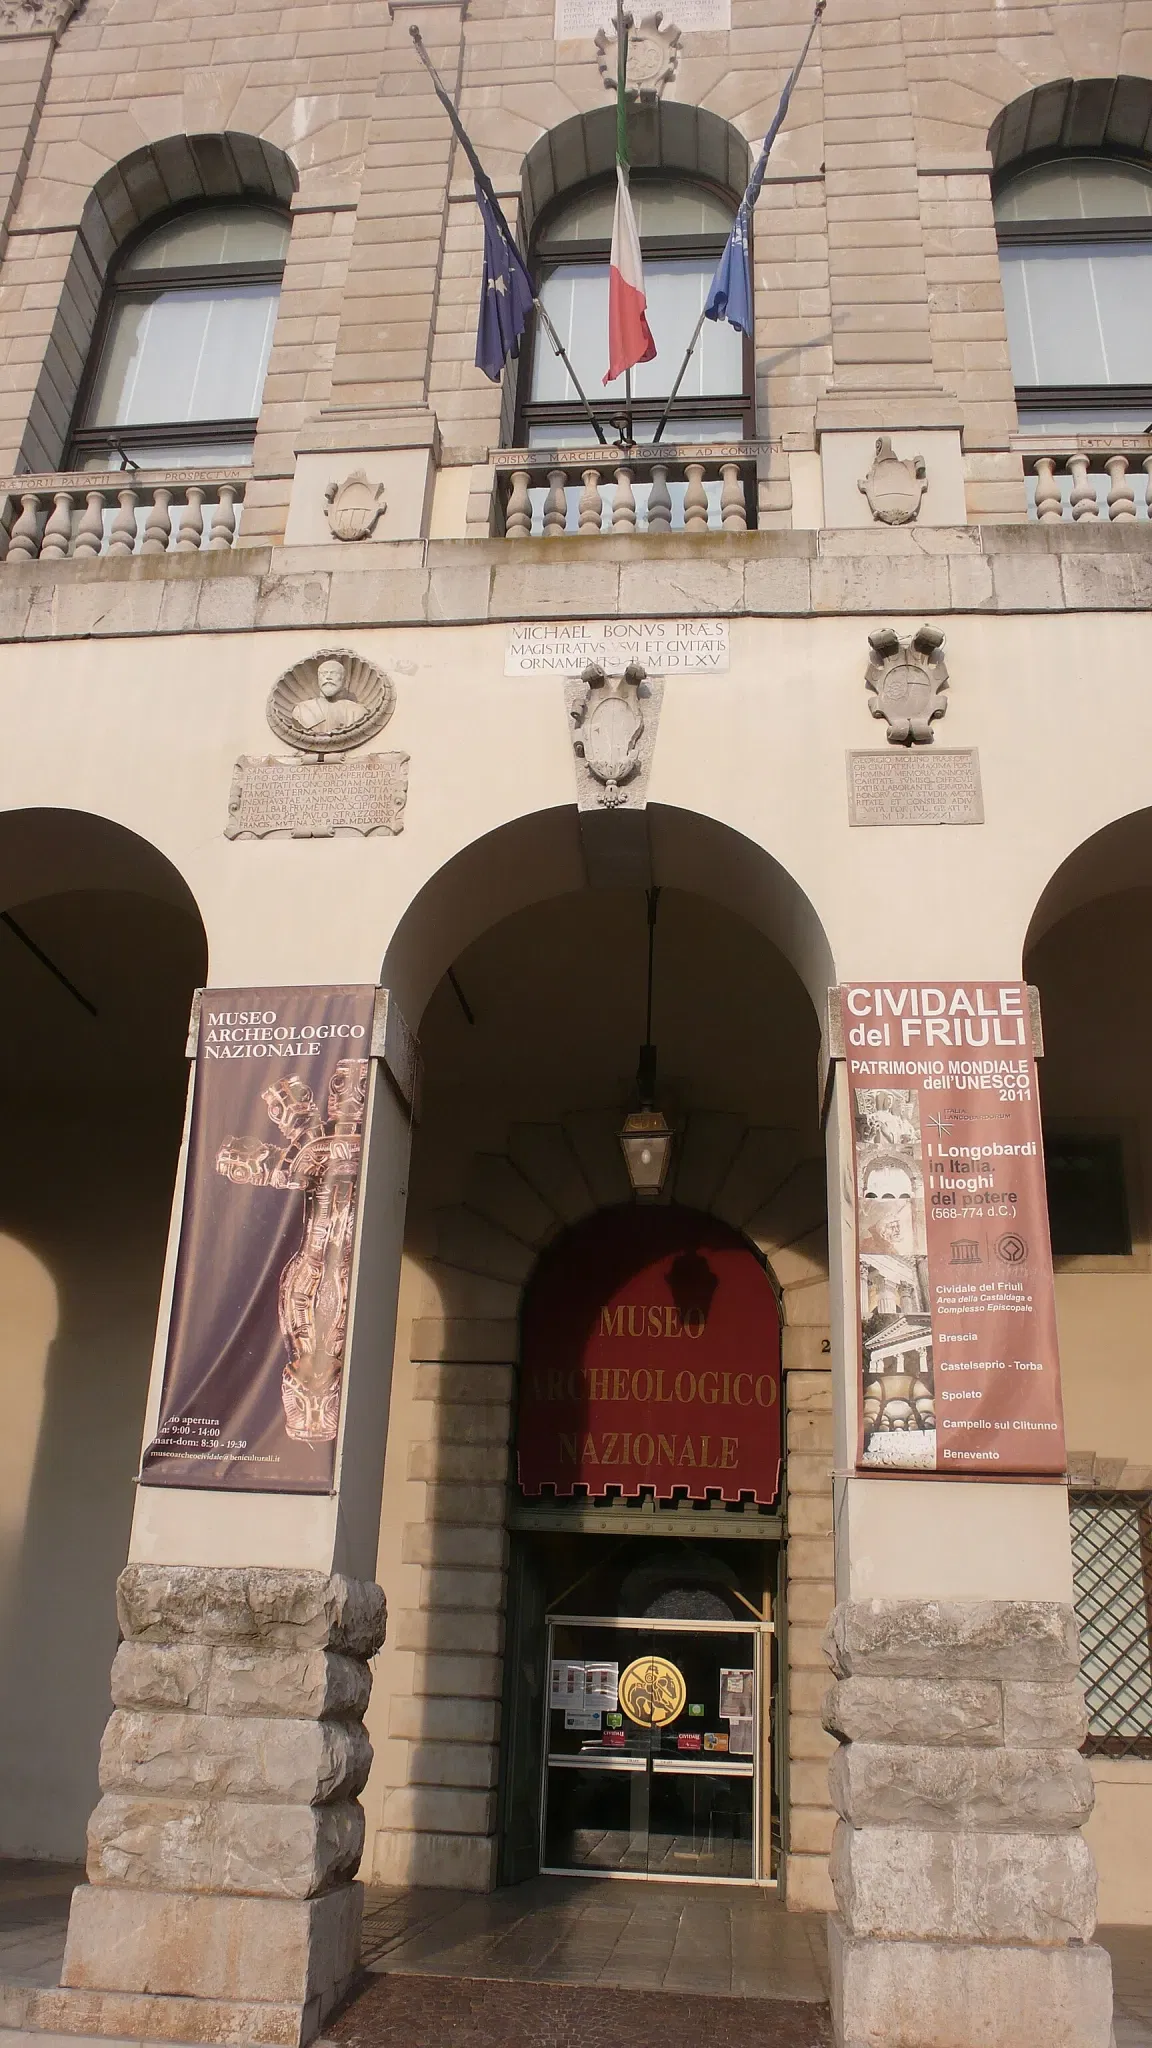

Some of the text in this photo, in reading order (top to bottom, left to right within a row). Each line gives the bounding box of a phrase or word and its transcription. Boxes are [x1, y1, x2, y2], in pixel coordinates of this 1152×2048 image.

[1122, 439, 1139, 447] ET
[549, 450, 618, 462] MARCELLO
[628, 449, 686, 458] PROVISOR
[512, 625, 591, 640] MICHAEL
[604, 624, 665, 638] BONVS
[510, 641, 605, 656] MAGISTRATVS
[646, 641, 663, 652] ET
[666, 640, 726, 652] CIVITATIS
[890, 798, 902, 806] ET
[847, 988, 1023, 1016] CIVIDALE
[207, 1011, 277, 1026] MUSEO
[205, 1024, 365, 1043] ARCHEOLOGICO
[849, 1018, 1026, 1046] del FRIULI
[204, 1042, 321, 1059] NAZIONALE
[851, 1060, 1028, 1075] PATRIMONIO MONDIALE
[924, 1075, 1030, 1089] dell'UNESCO
[1000, 1090, 1031, 1101] 2011
[928, 1142, 1036, 1160] I Longobardi
[929, 1160, 995, 1173] in Italia.
[930, 1174, 993, 1192] I luoghi
[931, 1192, 1017, 1207] del potere
[931, 1205, 1017, 1220] (568-774 d.C.)
[936, 1282, 1023, 1293] Cividale del Friuli
[936, 1296, 956, 1304] Area
[958, 1295, 977, 1303] della
[937, 1304, 1033, 1314] Complesso Episcopale
[599, 1305, 706, 1339] MUSEO
[939, 1333, 978, 1342] Brescia
[821, 1339, 831, 1353] 2
[940, 1360, 1005, 1371] Castelseprio
[1014, 1361, 1043, 1371] Torba
[941, 1391, 982, 1401] Spoleto
[182, 1417, 220, 1426] apertura
[943, 1420, 1058, 1430] Campello sul Clitunno
[172, 1426, 190, 1435] 9:00
[198, 1427, 220, 1436] 14:00
[201, 1438, 219, 1448] 8:30
[226, 1440, 247, 1449] 19:30
[557, 1432, 740, 1469] NAZIONALE
[943, 1450, 1000, 1460] Benevento
